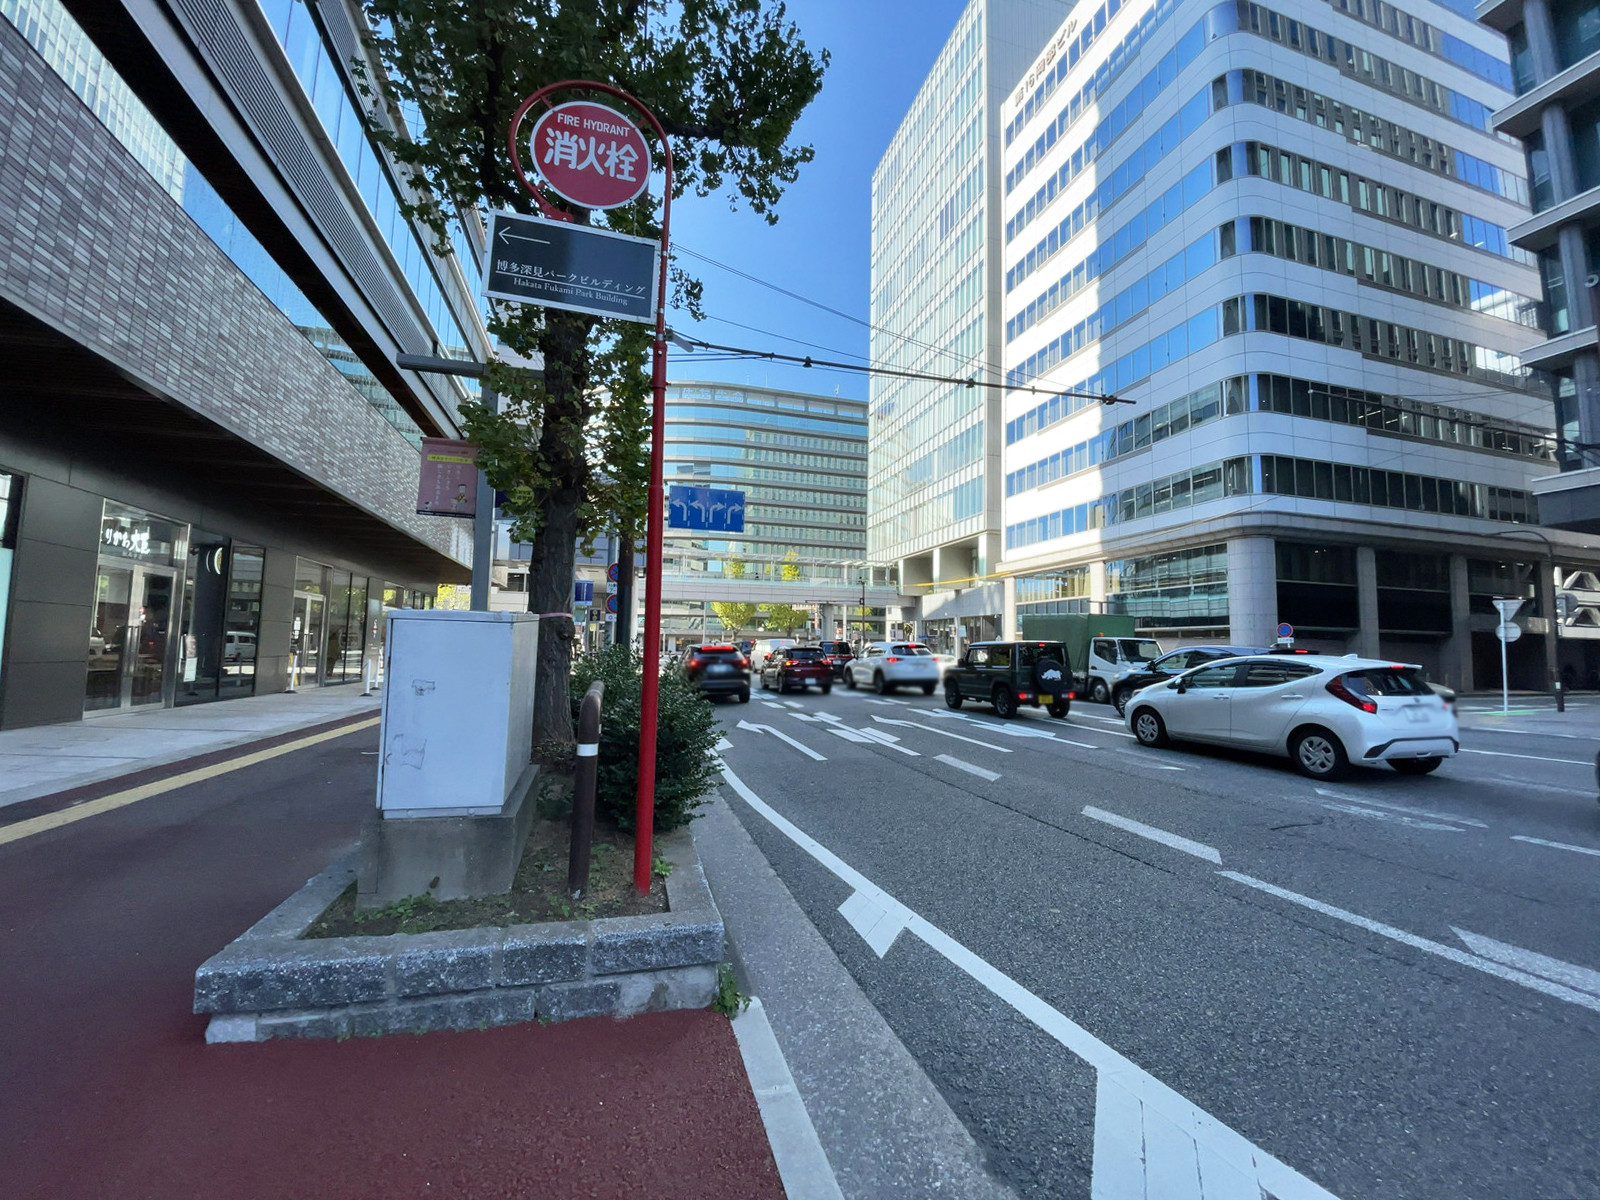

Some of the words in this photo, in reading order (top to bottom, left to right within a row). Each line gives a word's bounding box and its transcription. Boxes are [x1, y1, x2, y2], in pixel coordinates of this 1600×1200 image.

[557, 113, 580, 127] FIRE
[583, 118, 630, 137] HYDRANT
[543, 127, 639, 182] 消火栓
[496, 259, 646, 295] 博多深見パークビルディング
[513, 277, 542, 289] Hakata
[544, 283, 573, 295] Fukami
[575, 288, 594, 299] Park
[595, 291, 628, 306] Building
